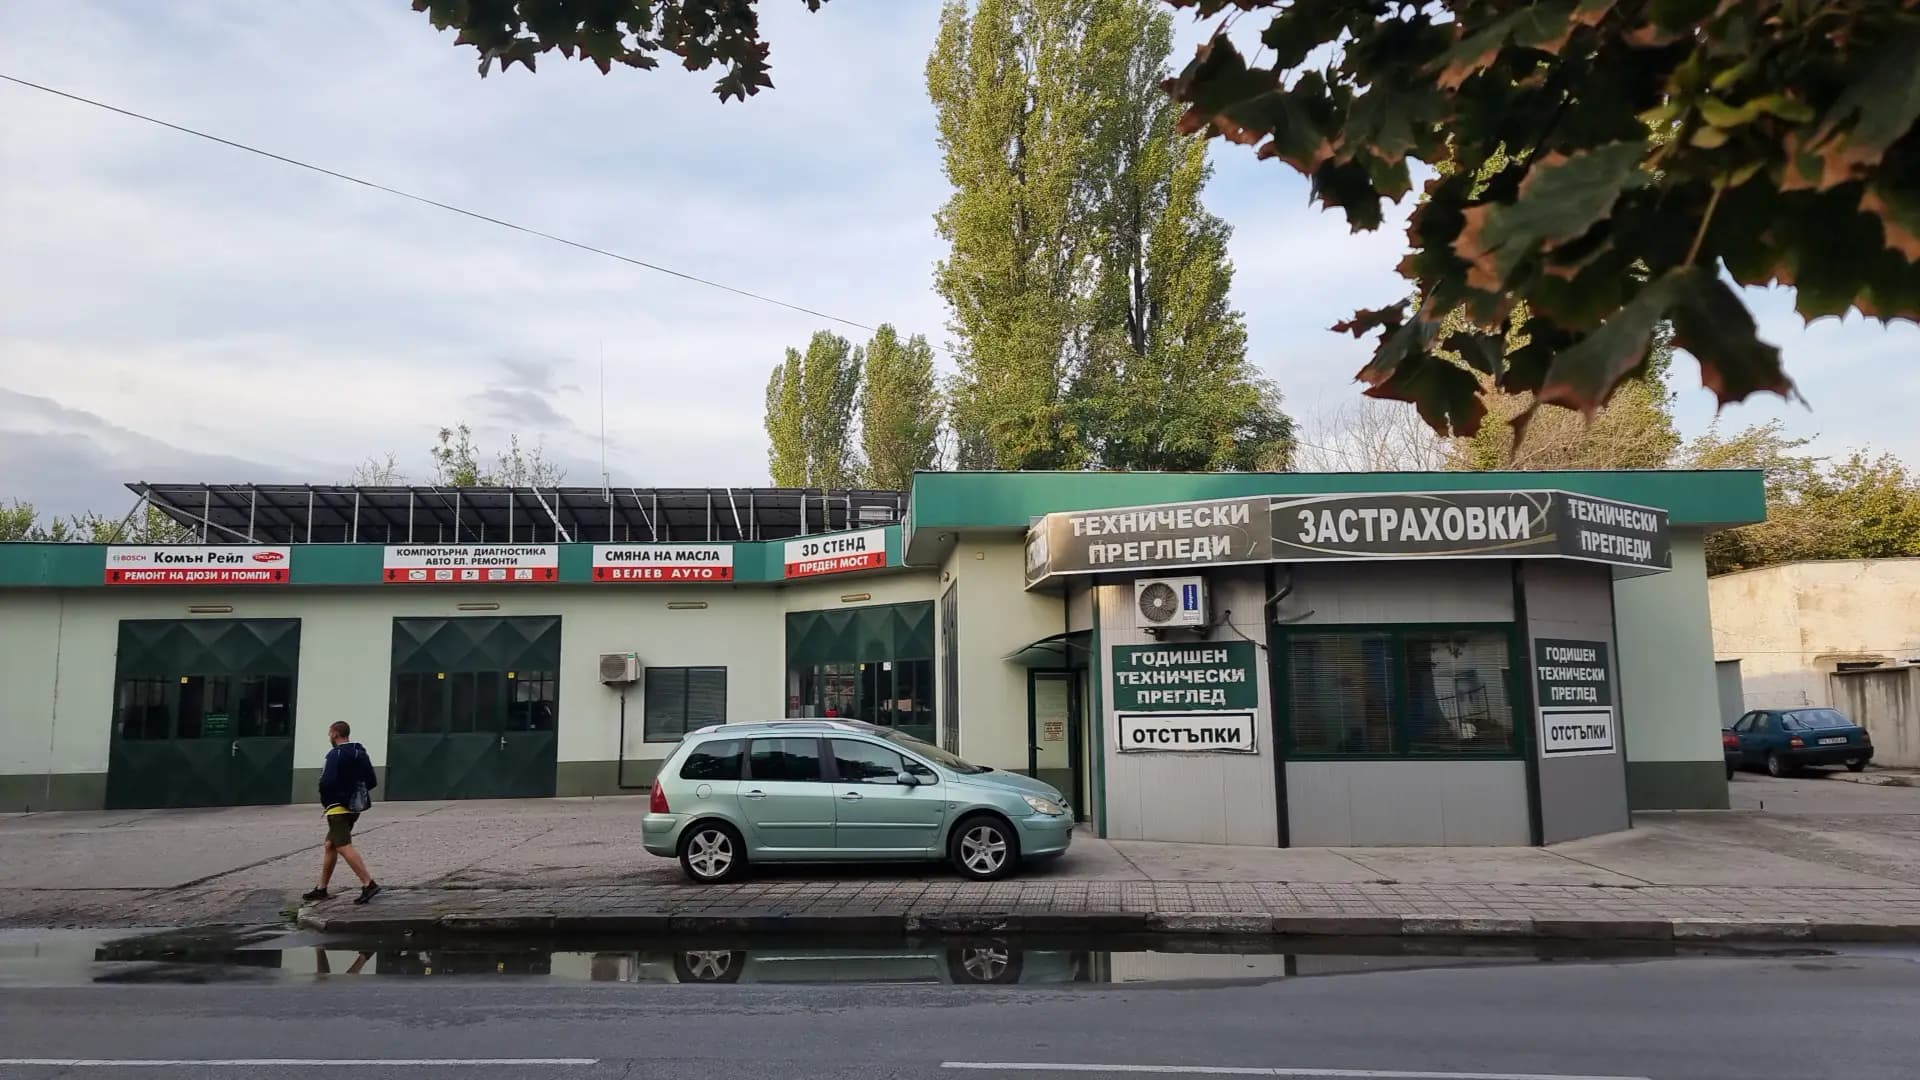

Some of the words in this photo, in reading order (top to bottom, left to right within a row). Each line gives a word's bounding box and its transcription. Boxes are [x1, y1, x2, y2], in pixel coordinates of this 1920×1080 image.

[1069, 503, 1249, 537] ТЕХНИЧЕСКИ
[1568, 498, 1658, 533] ТЕХНИЧЕСКИ
[1298, 506, 1530, 543] ЗАСТРАХОВКИ
[396, 548, 468, 557] КОМПЮТЪРНА
[473, 547, 546, 557] ДИАГНОСТИКА
[802, 543, 819, 556] 3D
[823, 537, 866, 554] СТЕНД
[1088, 535, 1231, 565] ПРЕГЛЕДИ
[1581, 530, 1652, 561] ПРЕГЛЕДИ
[154, 552, 203, 563] Комън
[207, 551, 244, 563] Рейл
[425, 557, 451, 566] АВТО
[453, 557, 469, 566] ЕЛ.
[471, 557, 518, 566] РЕМОНТИ
[605, 551, 650, 561] СМЯНА
[654, 551, 672, 561] НА
[675, 551, 720, 561] МАСЛА
[800, 561, 837, 573] ПРЕДЕН
[840, 556, 869, 567] МОСТ
[125, 571, 165, 580] РЕМОНТ
[169, 571, 184, 580] НА
[186, 571, 217, 581] ДЮЗИ
[221, 571, 229, 579] И
[232, 571, 270, 580] ПОМПИ
[612, 569, 662, 579] ВЕЛЕВ
[671, 569, 713, 579] АУТО
[1131, 649, 1228, 667] ГОДИШЕН
[1545, 646, 1596, 664] ГОДИШЕН
[1116, 668, 1246, 685] ТЕХНИЧЕСКИ
[1537, 666, 1605, 681] ТЕХНИЧЕСКИ
[1137, 689, 1226, 706] ПРЕГЛЕД
[1551, 686, 1597, 703] ПРЕГЛЕД
[1132, 727, 1241, 744] ОТСТЪПКИ
[1551, 724, 1607, 741] ОТСТЪПКИ
